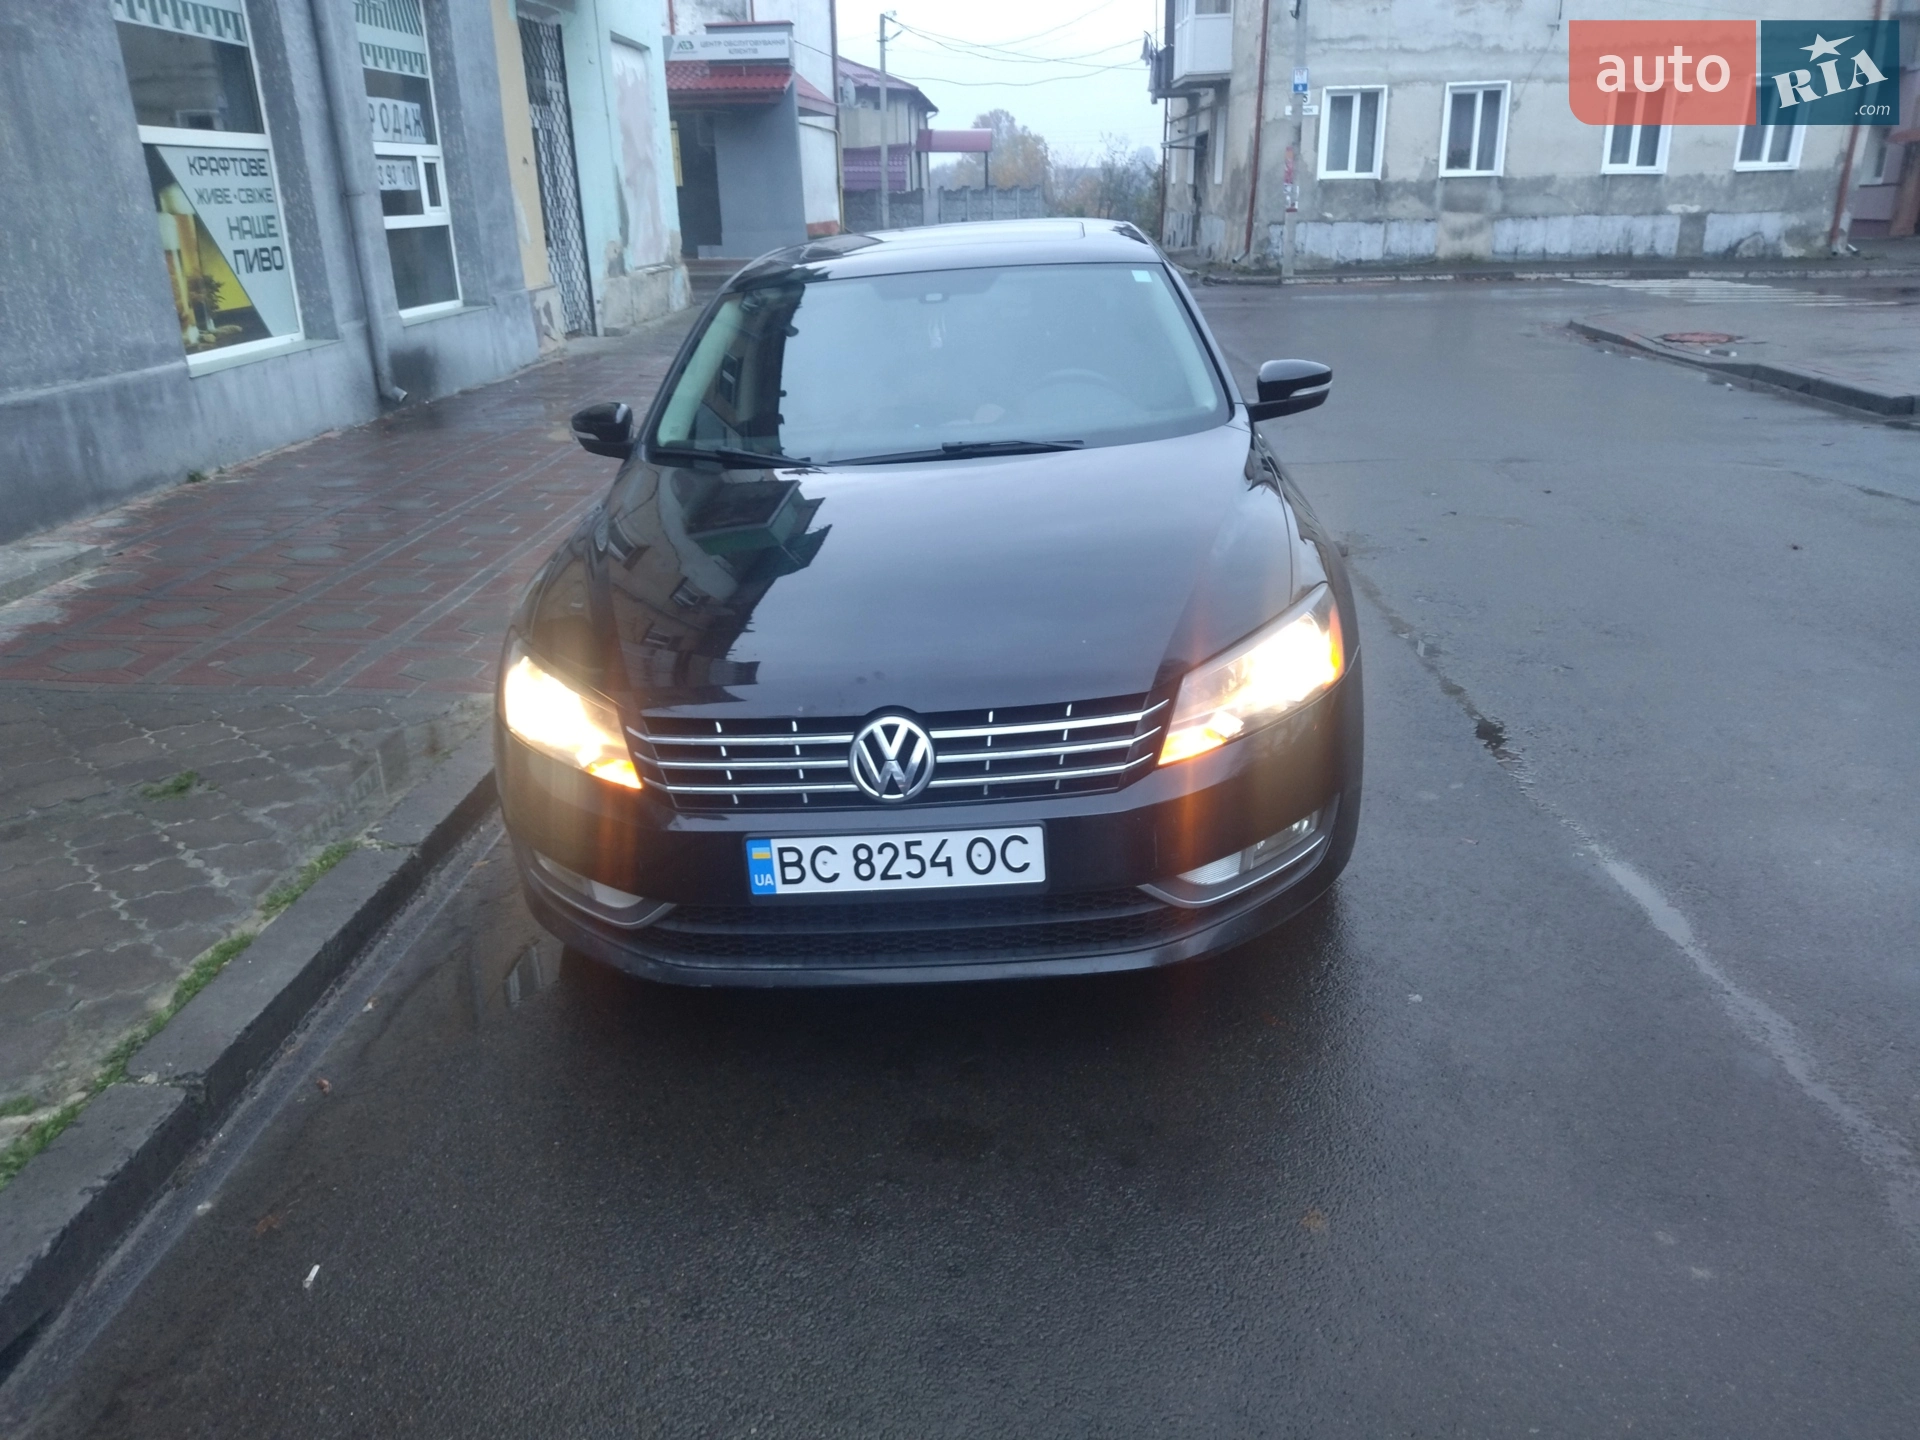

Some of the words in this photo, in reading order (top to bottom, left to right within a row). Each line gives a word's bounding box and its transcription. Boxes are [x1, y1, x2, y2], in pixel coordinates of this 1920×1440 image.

[187, 155, 269, 177] КРАФТОВЕ
[194, 187, 233, 205] ЖИВЕ
[226, 214, 279, 241] НАШЕ
[233, 245, 285, 275] ПИВО
[777, 844, 841, 886] BC
[851, 837, 954, 882] 8254
[965, 833, 1031, 876] OC
[754, 873, 775, 888] UA
